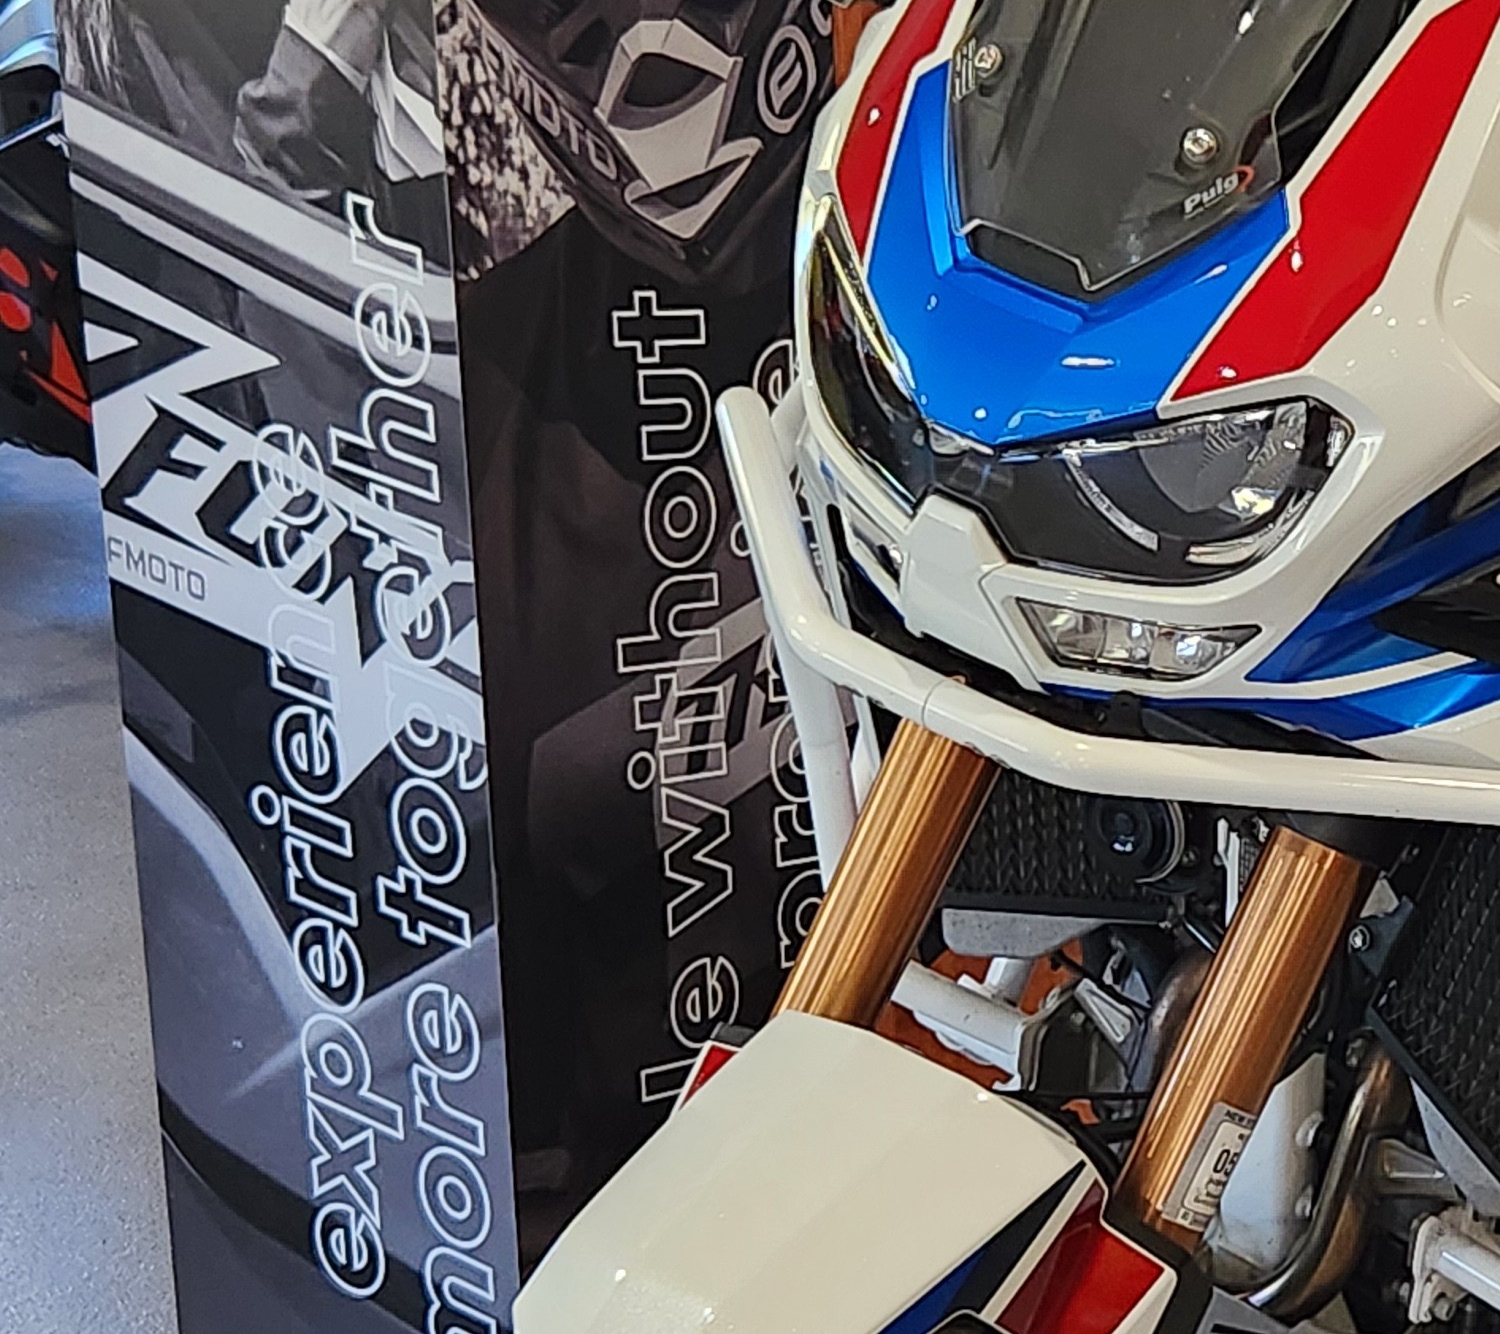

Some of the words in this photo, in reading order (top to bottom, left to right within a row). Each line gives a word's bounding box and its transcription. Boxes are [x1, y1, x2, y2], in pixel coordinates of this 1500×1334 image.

[1183, 170, 1242, 219] Puig
[107, 535, 207, 602] FMOTO
[250, 421, 404, 1300] experience
[329, 188, 489, 949] together
[612, 289, 735, 938] without
